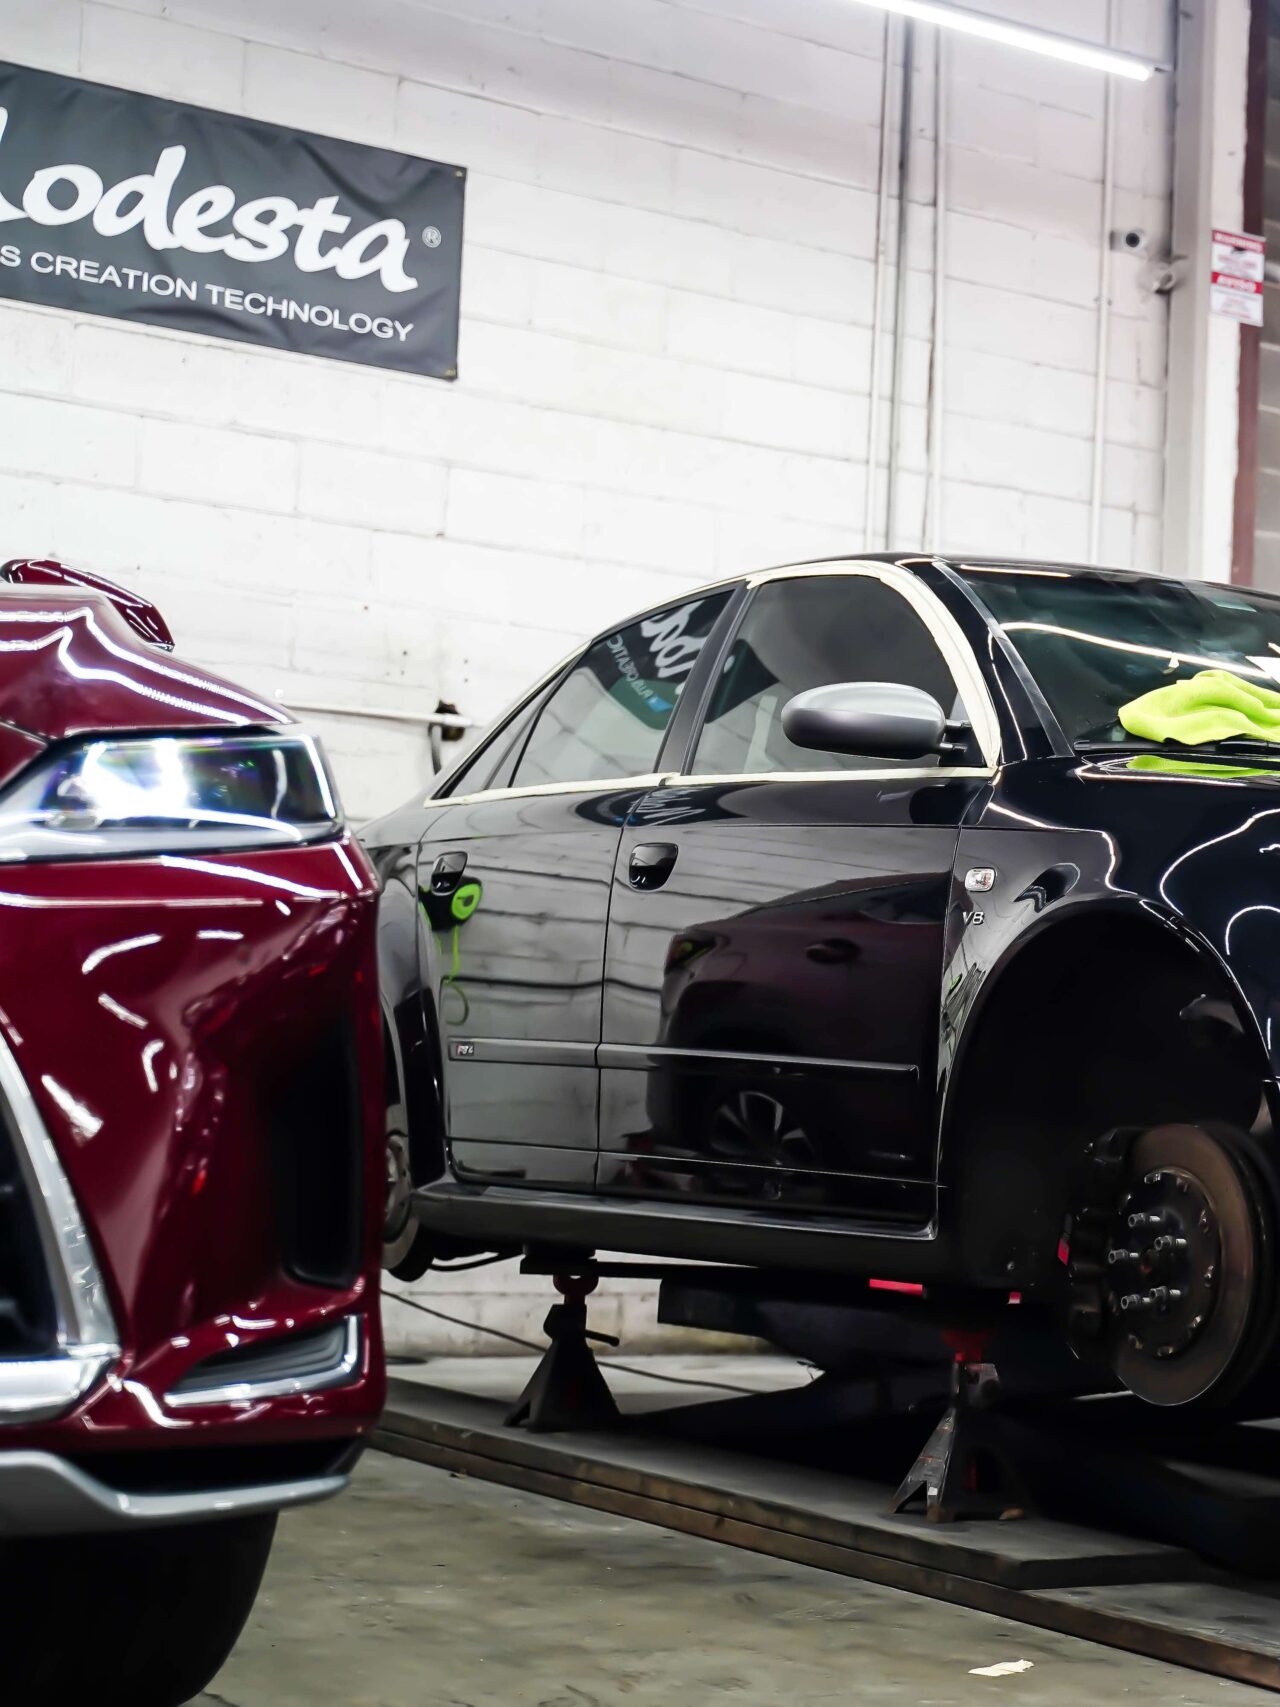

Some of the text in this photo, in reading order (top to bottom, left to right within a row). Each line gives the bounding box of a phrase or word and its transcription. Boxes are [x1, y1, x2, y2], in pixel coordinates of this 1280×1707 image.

[30, 251, 197, 301] CREATION
[205, 283, 414, 342] TECHNOLOGY
[962, 911, 984, 925] V8
